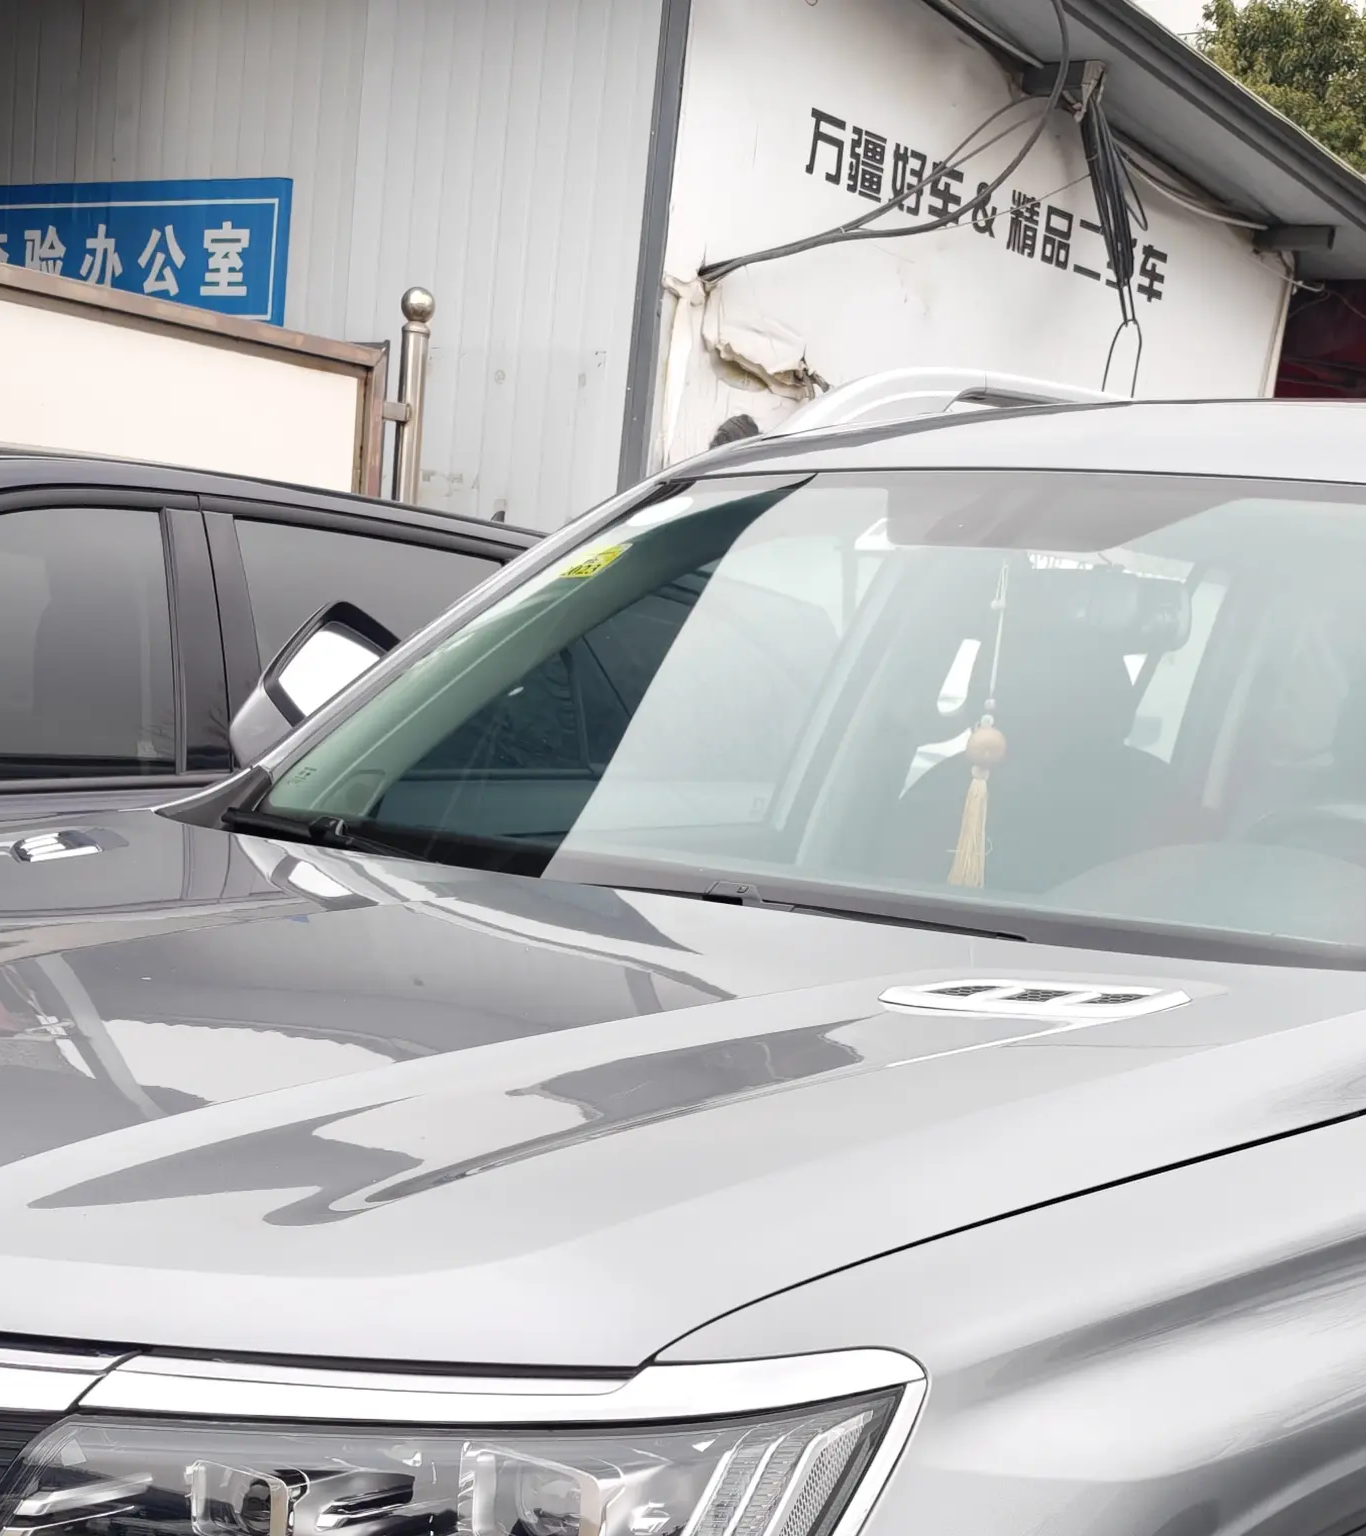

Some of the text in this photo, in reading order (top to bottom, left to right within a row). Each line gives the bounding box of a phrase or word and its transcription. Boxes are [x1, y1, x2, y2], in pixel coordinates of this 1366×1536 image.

[805, 107, 1169, 303] 万疆好车&精品二车
